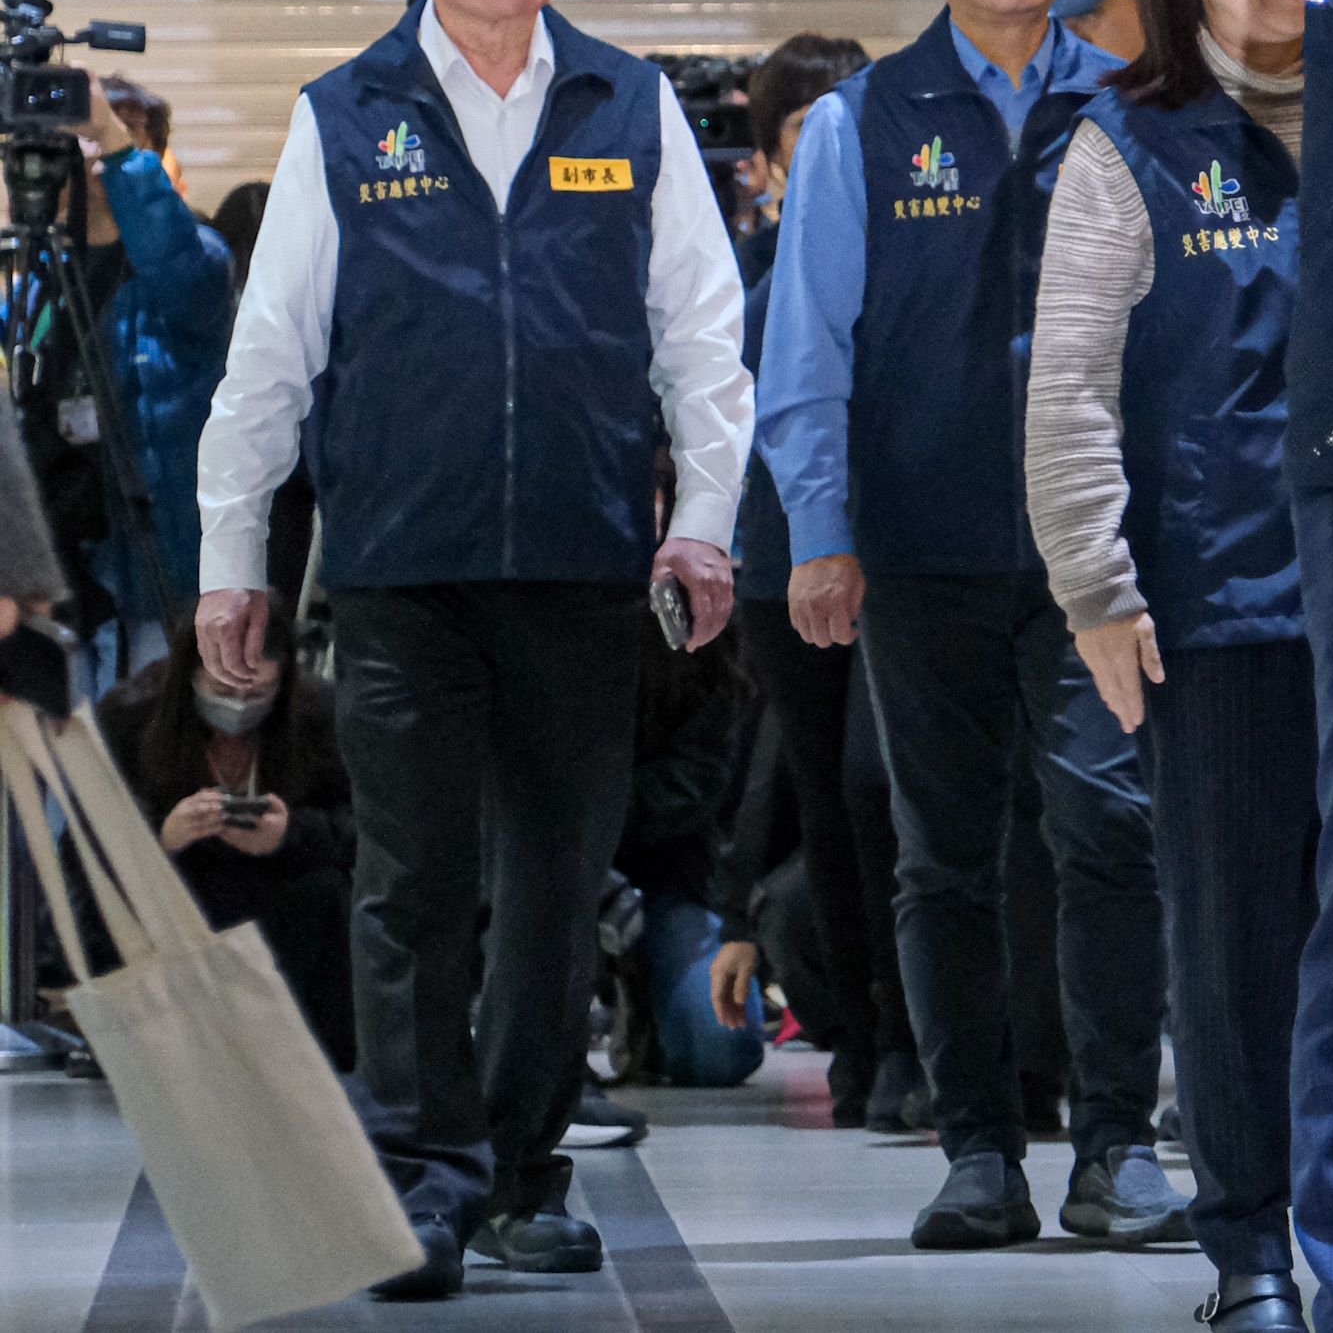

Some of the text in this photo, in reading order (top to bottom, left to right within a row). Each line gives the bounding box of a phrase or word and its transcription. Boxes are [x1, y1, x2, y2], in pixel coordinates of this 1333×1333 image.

[562, 166, 618, 185] 副市長
[1182, 225, 1280, 258] 災害應變中心
